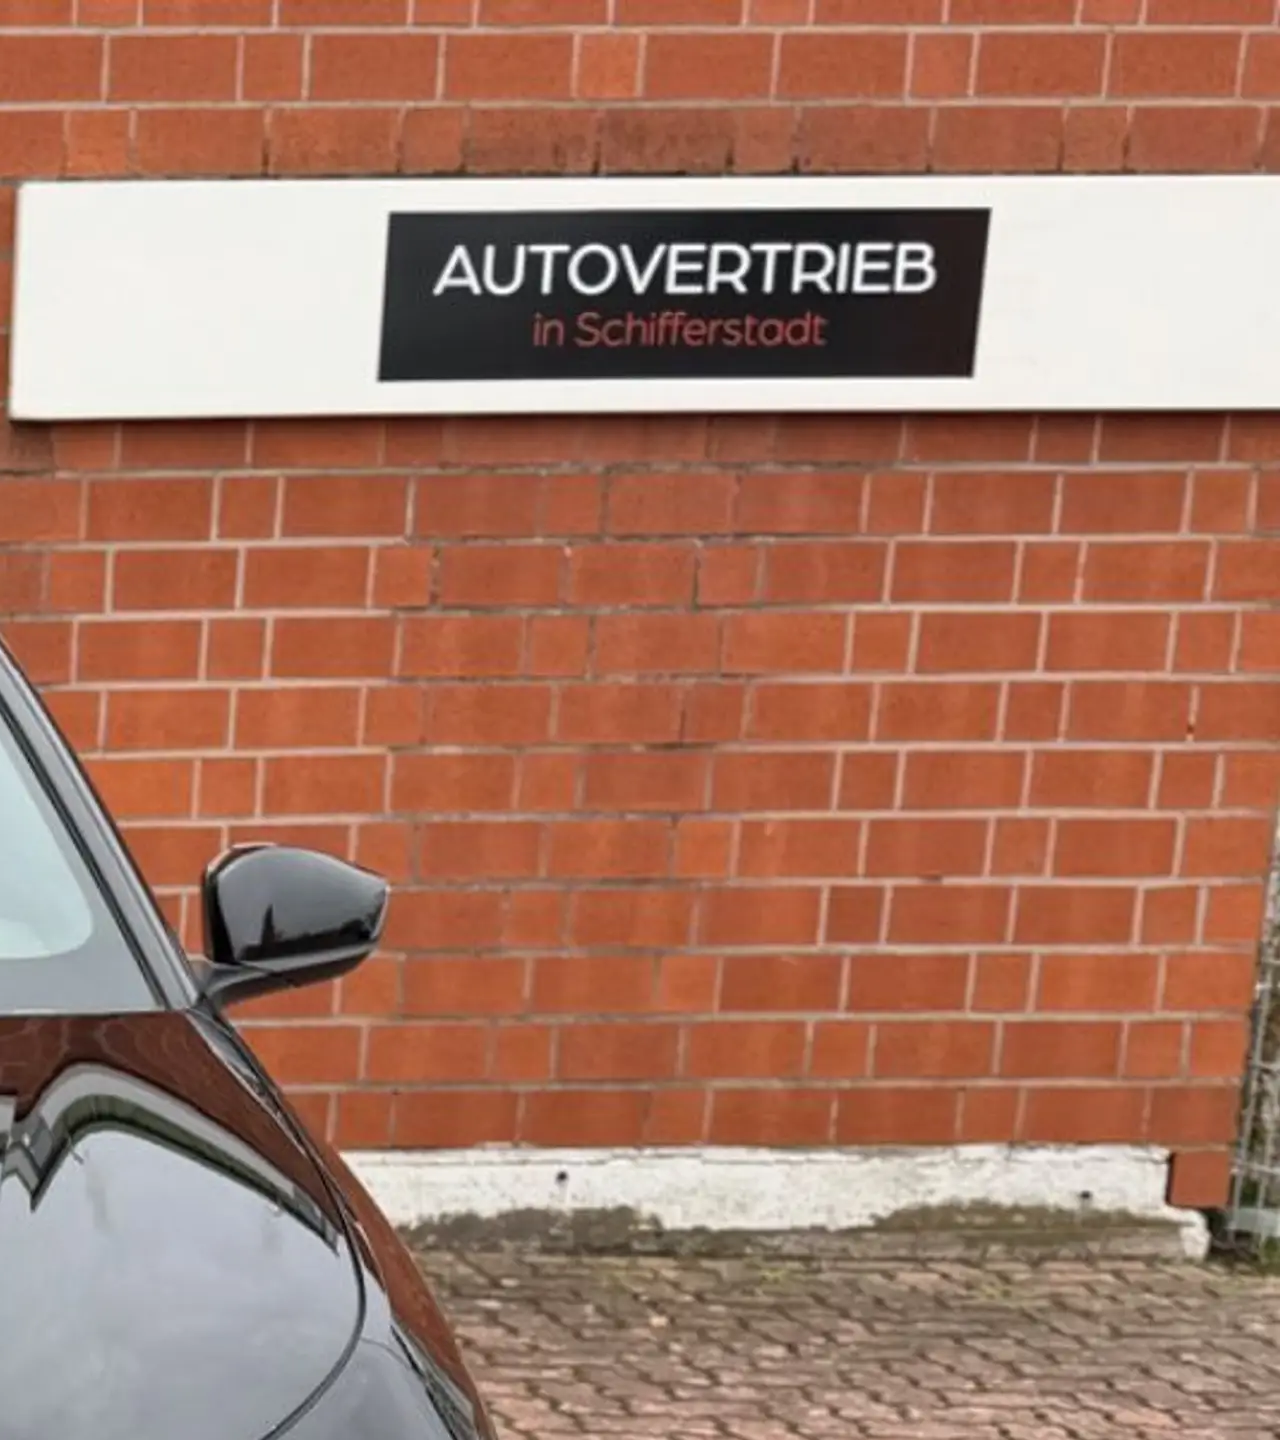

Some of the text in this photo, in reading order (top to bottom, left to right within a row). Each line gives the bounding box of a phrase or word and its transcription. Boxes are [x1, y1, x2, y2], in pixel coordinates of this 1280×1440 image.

[433, 242, 938, 296] AUTOVERTRIEB
[532, 311, 828, 349] in Schifferstadt
